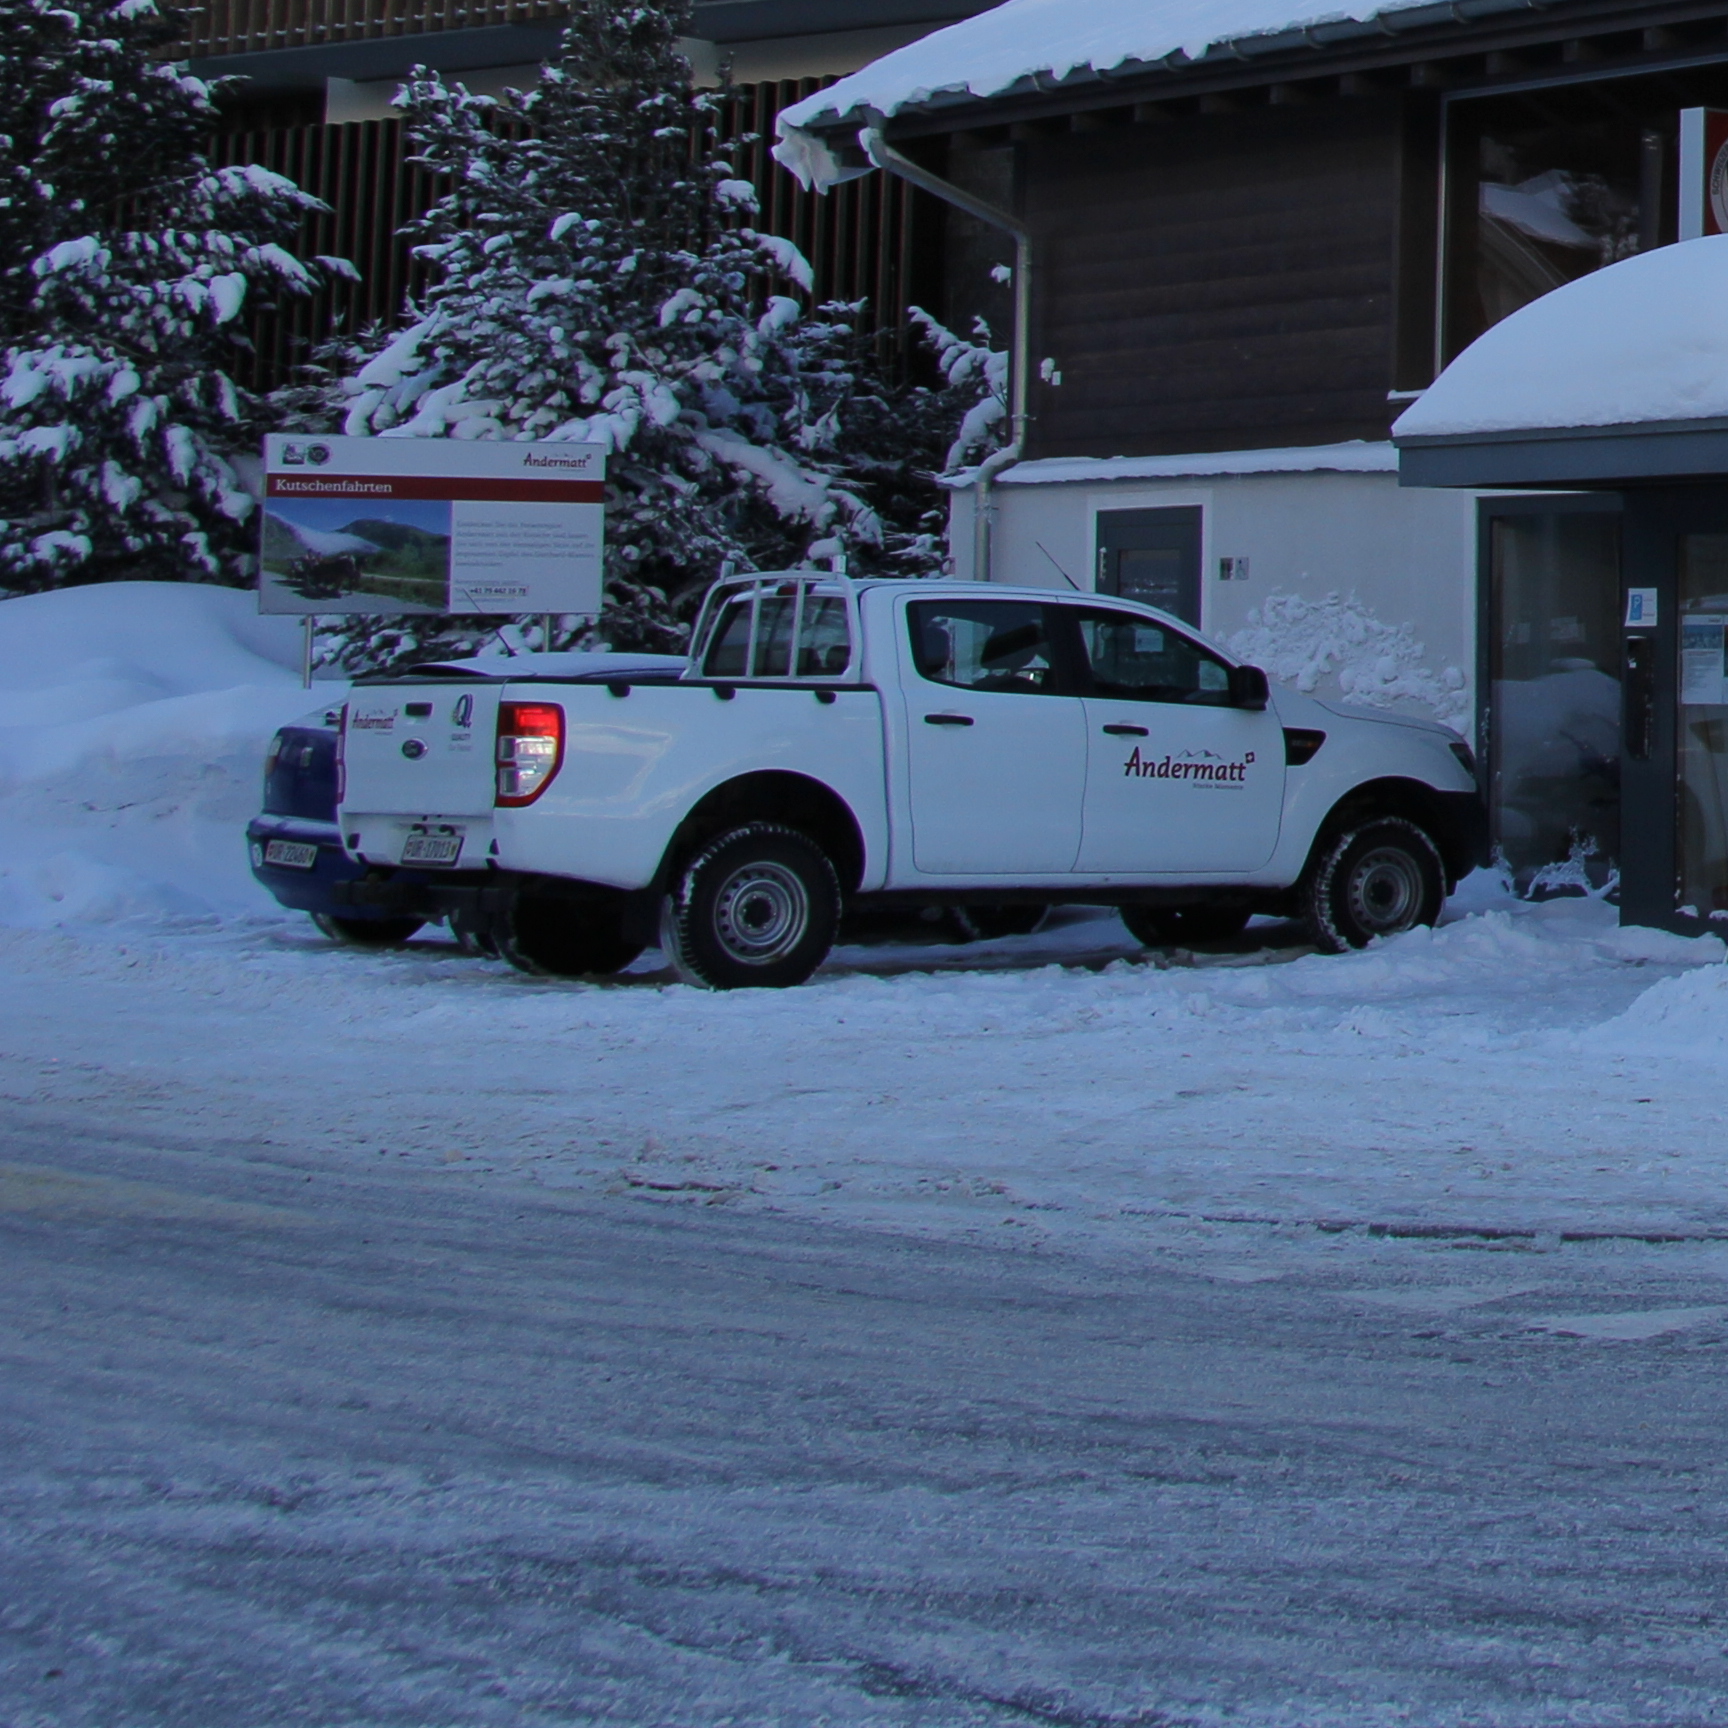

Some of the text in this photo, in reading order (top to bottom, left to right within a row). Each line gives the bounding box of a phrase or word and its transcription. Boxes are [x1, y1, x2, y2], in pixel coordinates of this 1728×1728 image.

[523, 452, 589, 469] Andermatt
[275, 478, 393, 494] Kutschenfahrten
[353, 709, 395, 729] Andermatt
[1124, 746, 1247, 782] Andermatt
